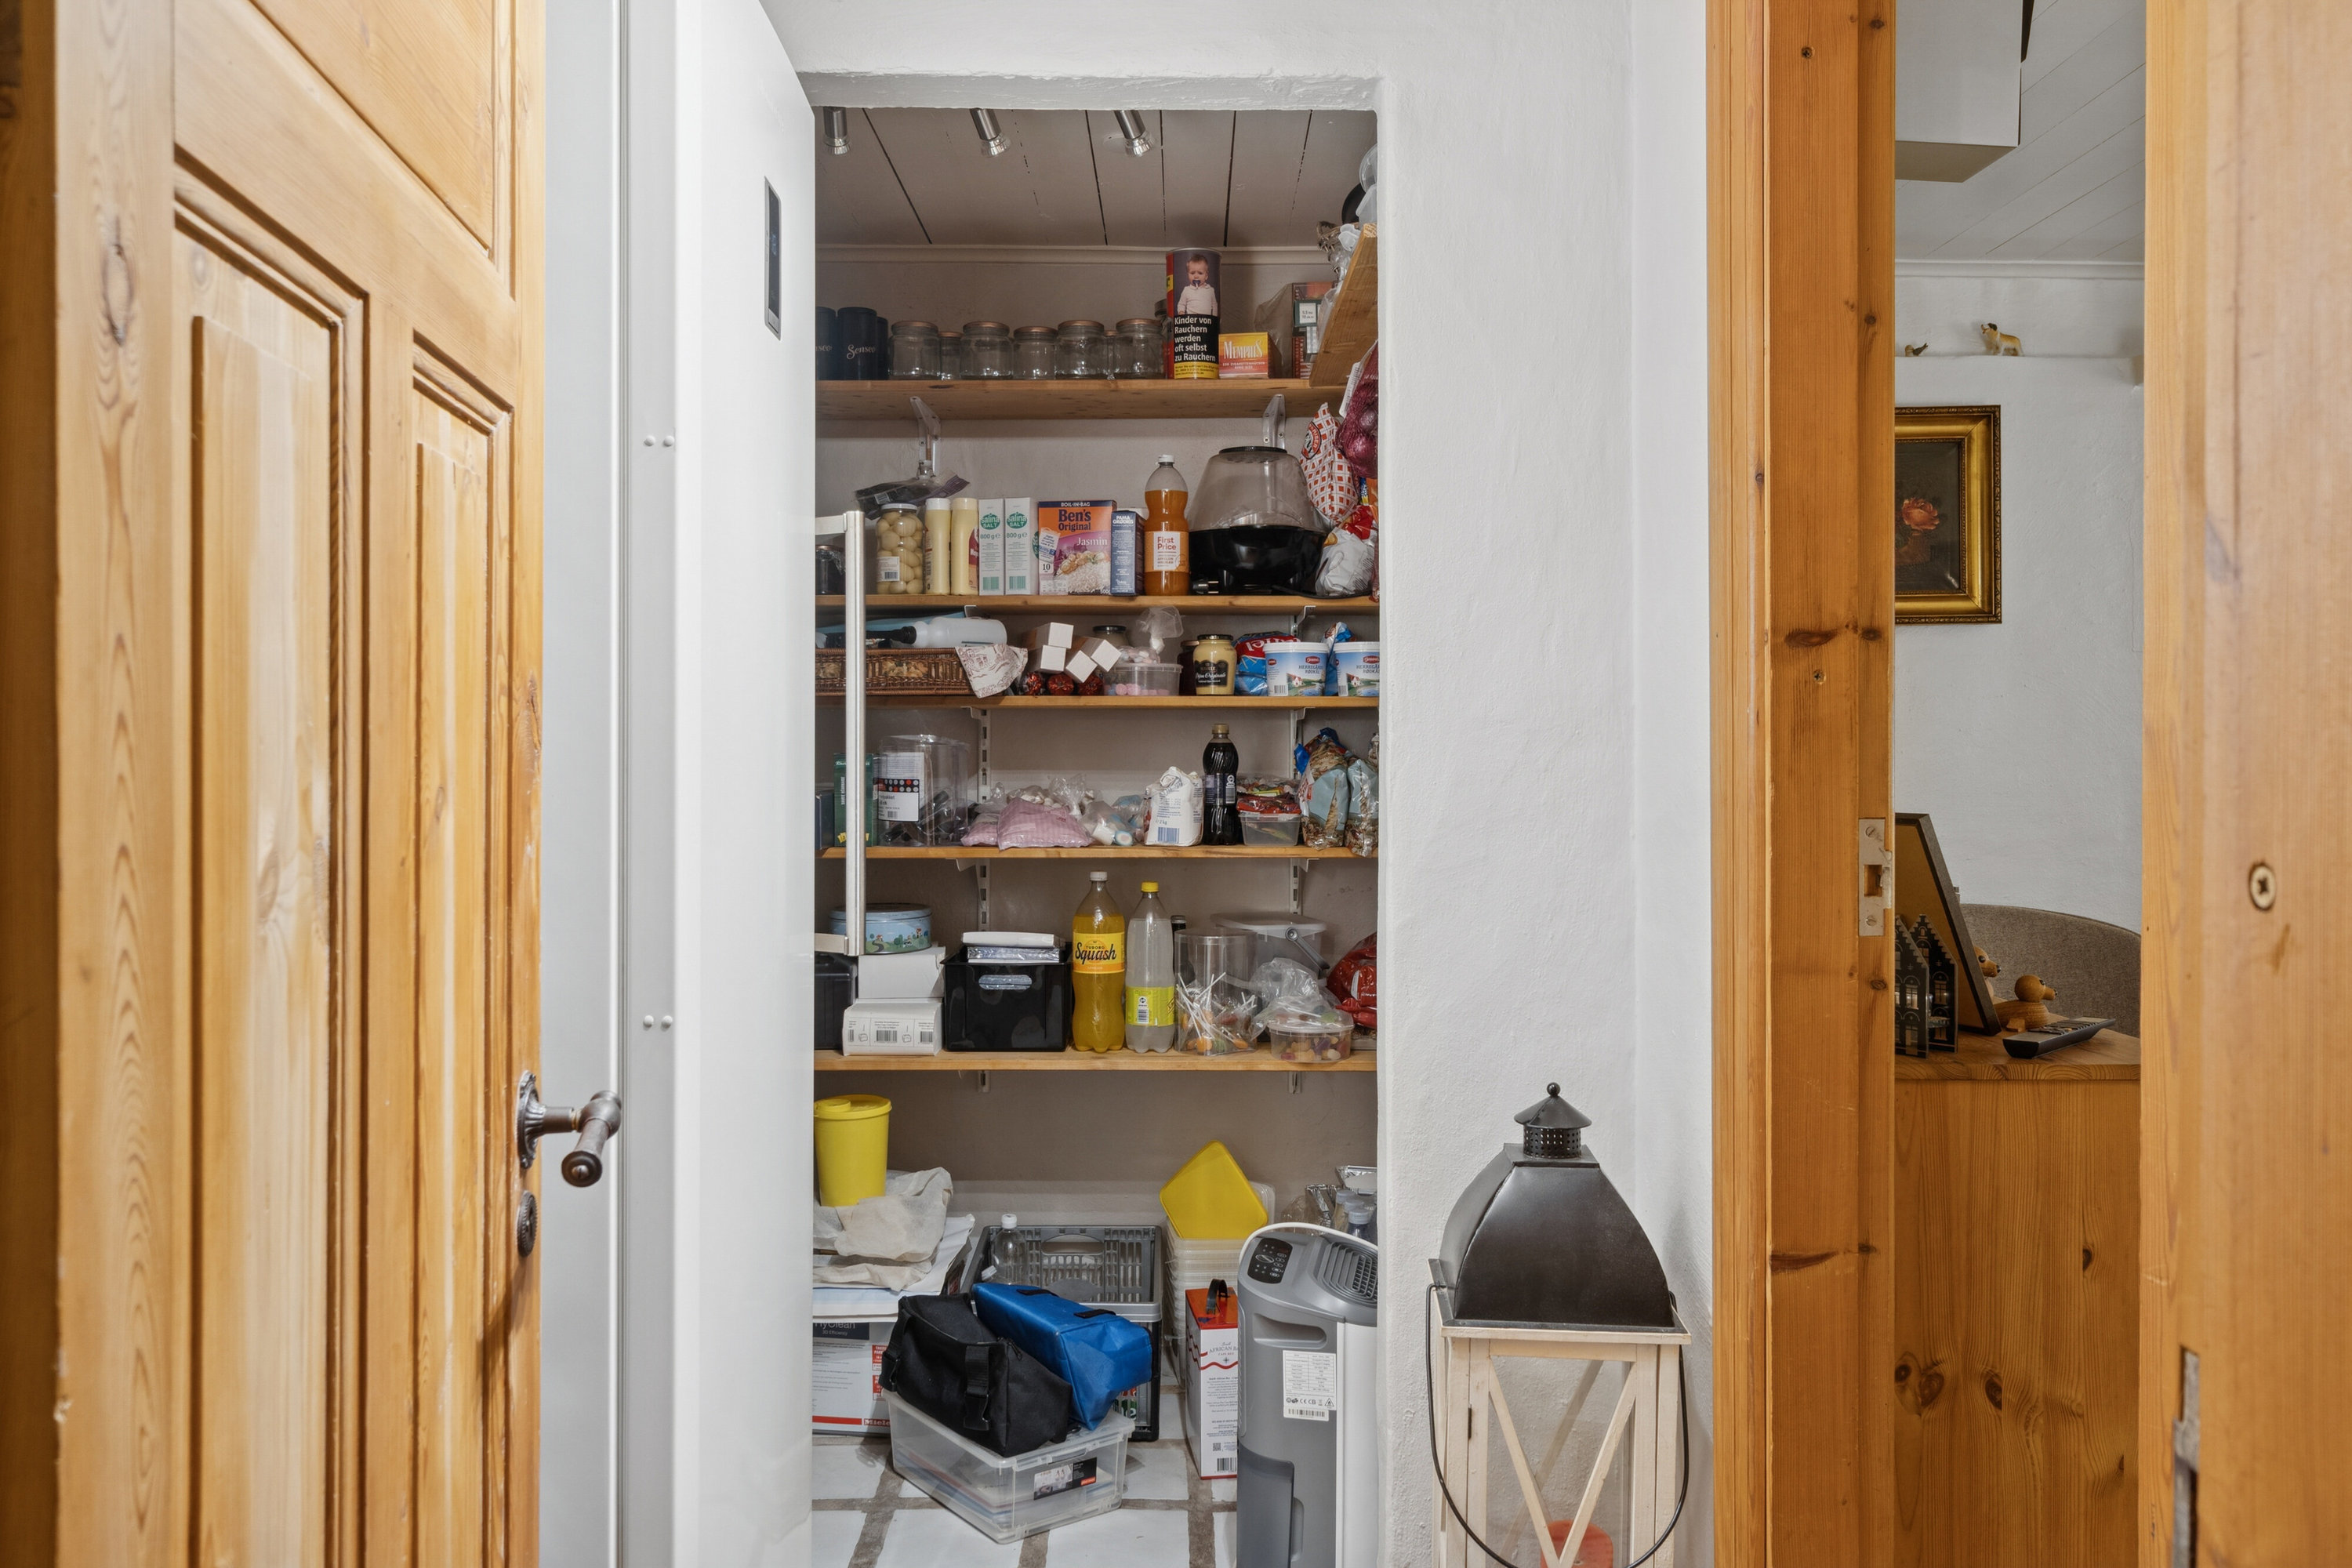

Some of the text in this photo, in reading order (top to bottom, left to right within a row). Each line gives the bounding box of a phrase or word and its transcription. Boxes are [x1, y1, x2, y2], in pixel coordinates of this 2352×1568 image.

[1174, 315, 1197, 325] Kinder
[1174, 325, 1207, 334] Rauchern
[1174, 334, 1201, 343] werden
[1174, 343, 1207, 353] oft selbst
[1183, 352, 1216, 362] Rauchern
[1058, 509, 1091, 522] Ben's
[1058, 522, 1091, 532] Original
[1076, 537, 1108, 546] Jasmin
[1075, 942, 1117, 965] Squash
